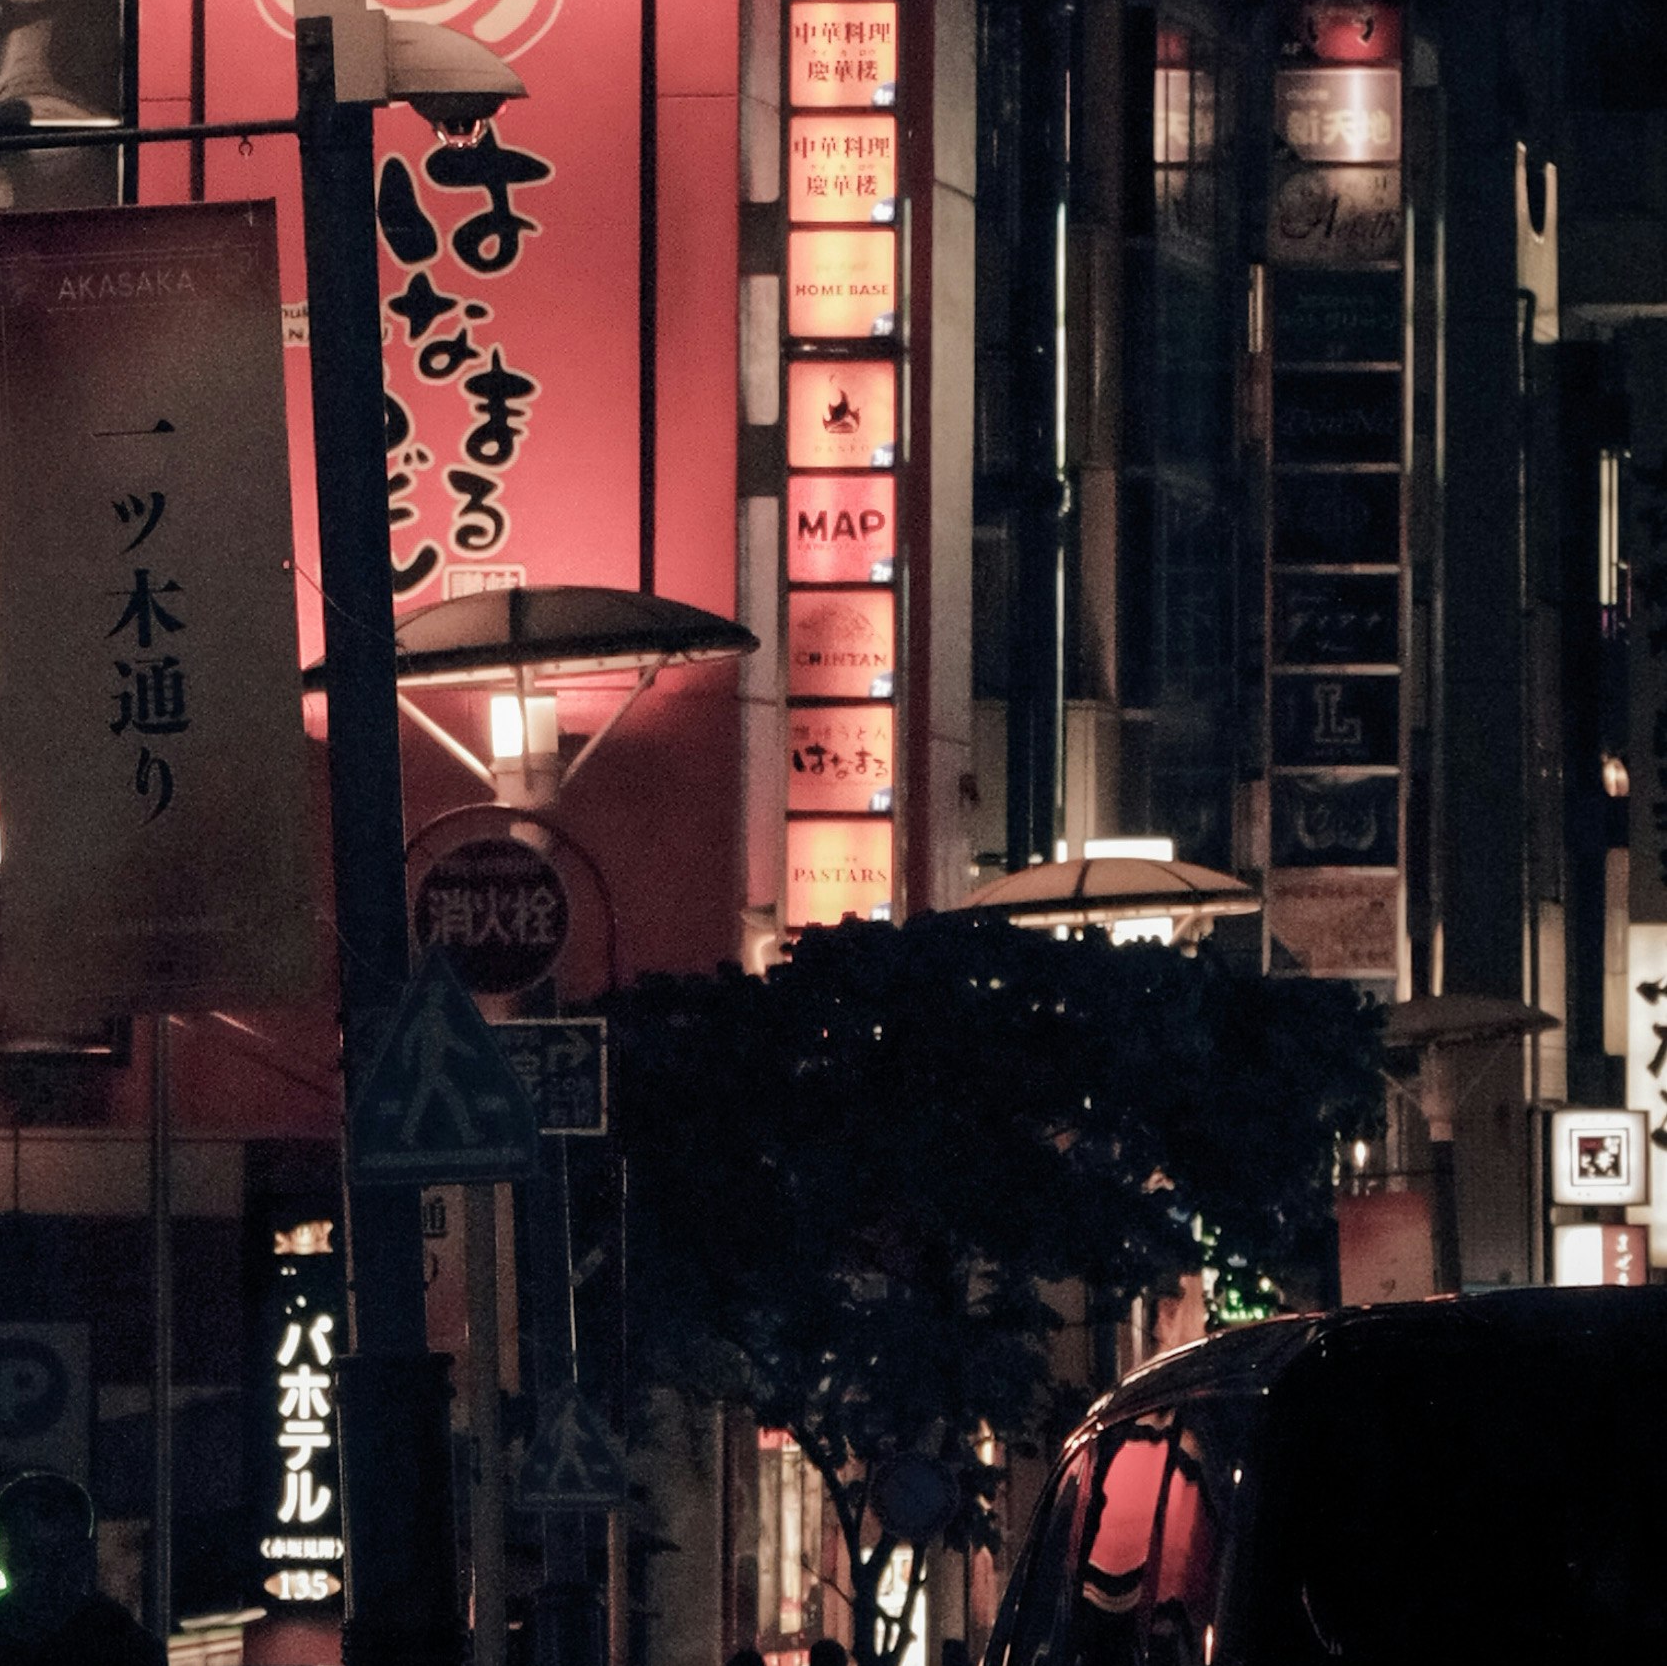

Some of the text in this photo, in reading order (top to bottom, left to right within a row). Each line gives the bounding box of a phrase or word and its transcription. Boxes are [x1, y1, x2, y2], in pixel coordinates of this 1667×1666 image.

[794, 21, 891, 46] 中華料理
[57, 269, 196, 301] AKASAKA
[795, 284, 890, 296] HOME BASE
[797, 508, 886, 543] MAP
[93, 418, 192, 827] 一ツ木通り
[793, 868, 888, 883] PASTARS
[427, 884, 557, 946] 消火栓
[277, 1267, 334, 1525] パホテル
[278, 1568, 329, 1602] 135
